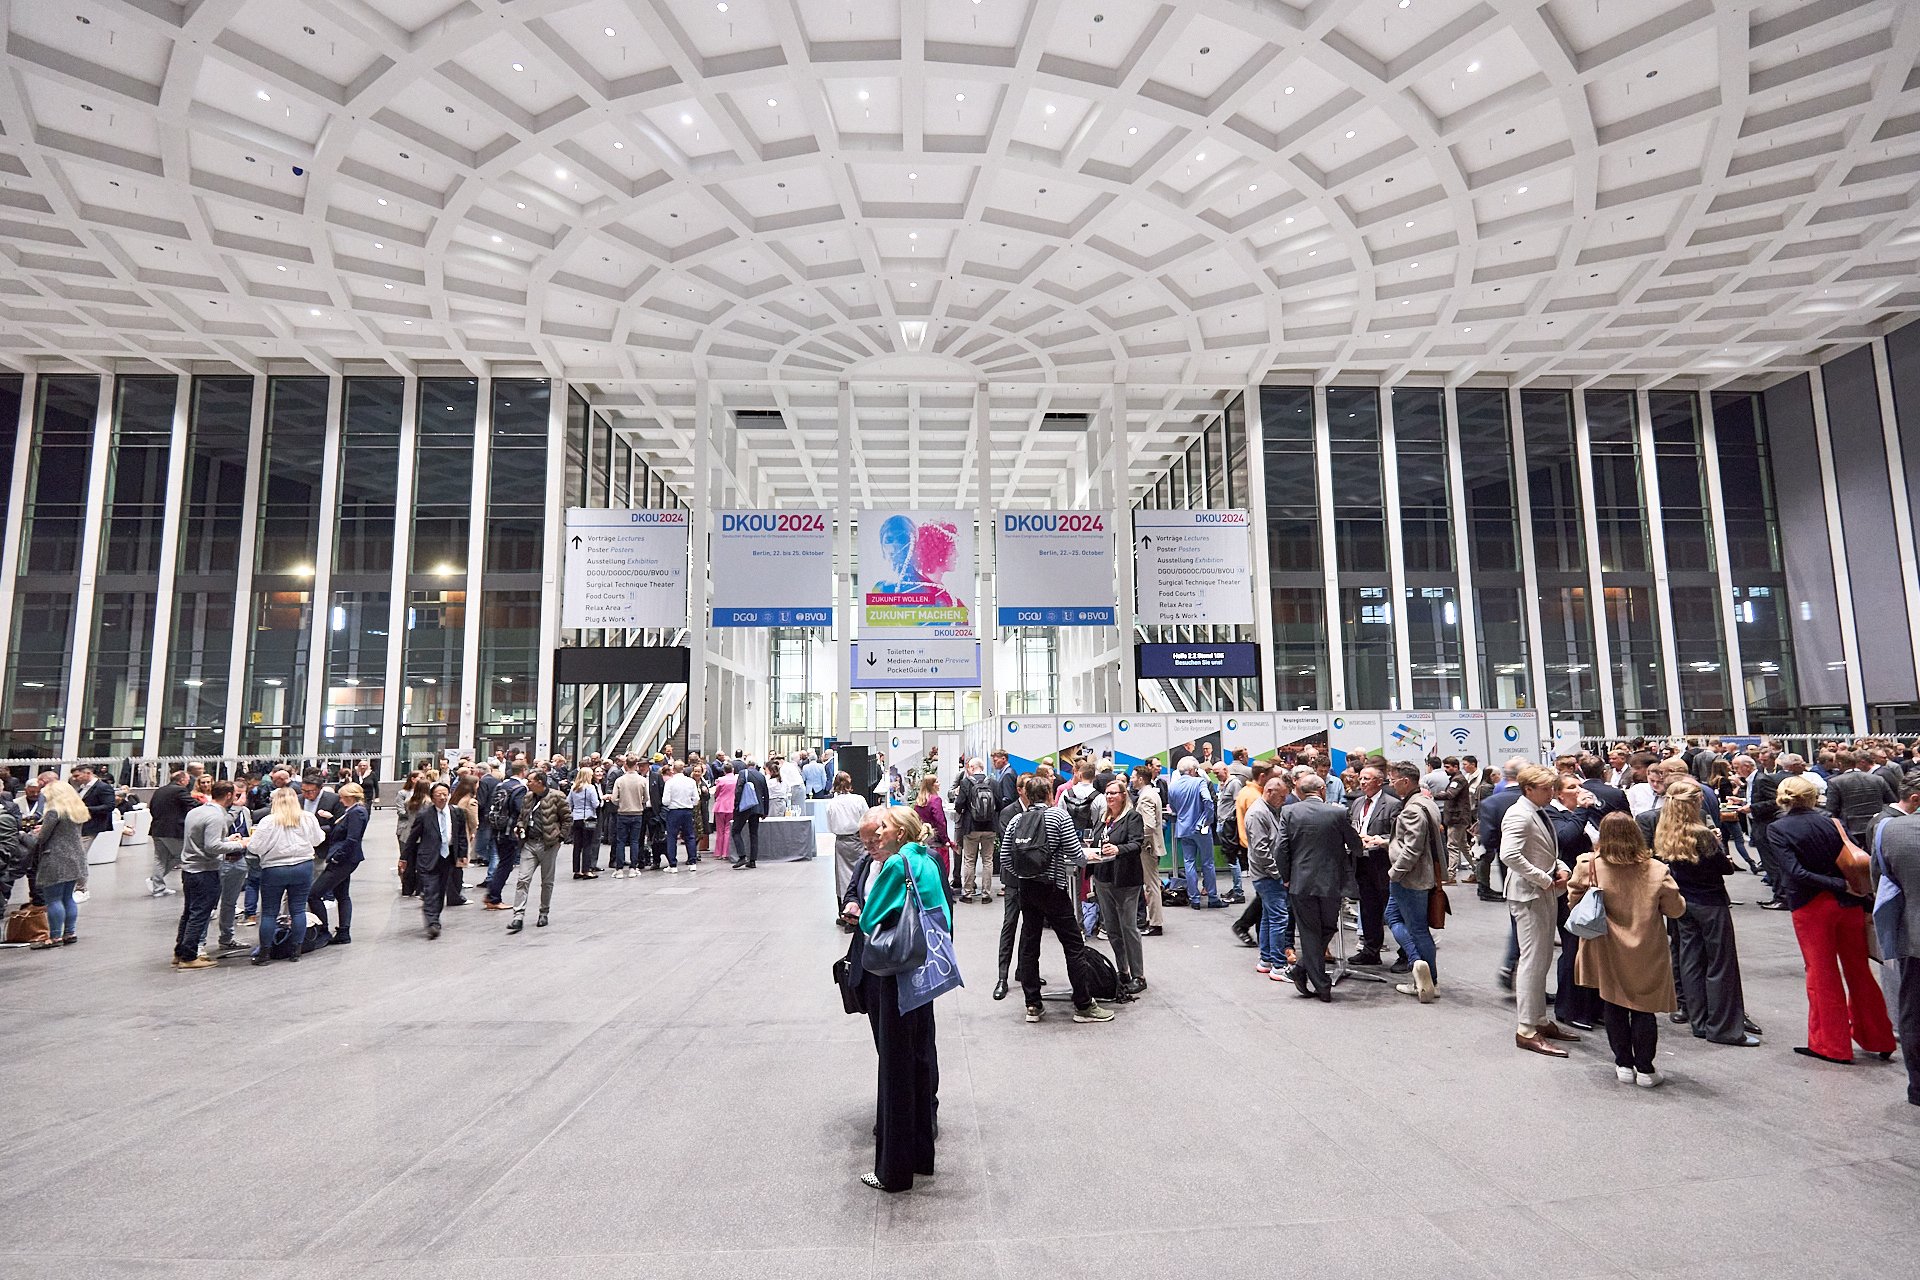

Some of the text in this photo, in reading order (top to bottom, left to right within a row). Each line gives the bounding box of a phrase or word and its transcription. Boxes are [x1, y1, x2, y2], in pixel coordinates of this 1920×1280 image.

[631, 513, 684, 523] DKOU2024
[1195, 514, 1244, 523] DKOU2024
[722, 514, 825, 532] DKOU2024
[1004, 514, 1104, 532] DKOU2024
[588, 535, 616, 543] Vorträge
[1156, 535, 1183, 543] Vorträge
[1157, 557, 1194, 565] Ausstellung
[586, 581, 613, 589] Surgical
[615, 581, 648, 589] Technique
[1158, 579, 1184, 587] Surgical
[1185, 579, 1216, 587] Technique
[870, 610, 964, 620] ZUKUNFT MACHEN.
[585, 616, 600, 624] Plug
[934, 629, 973, 637] DKOU2024
